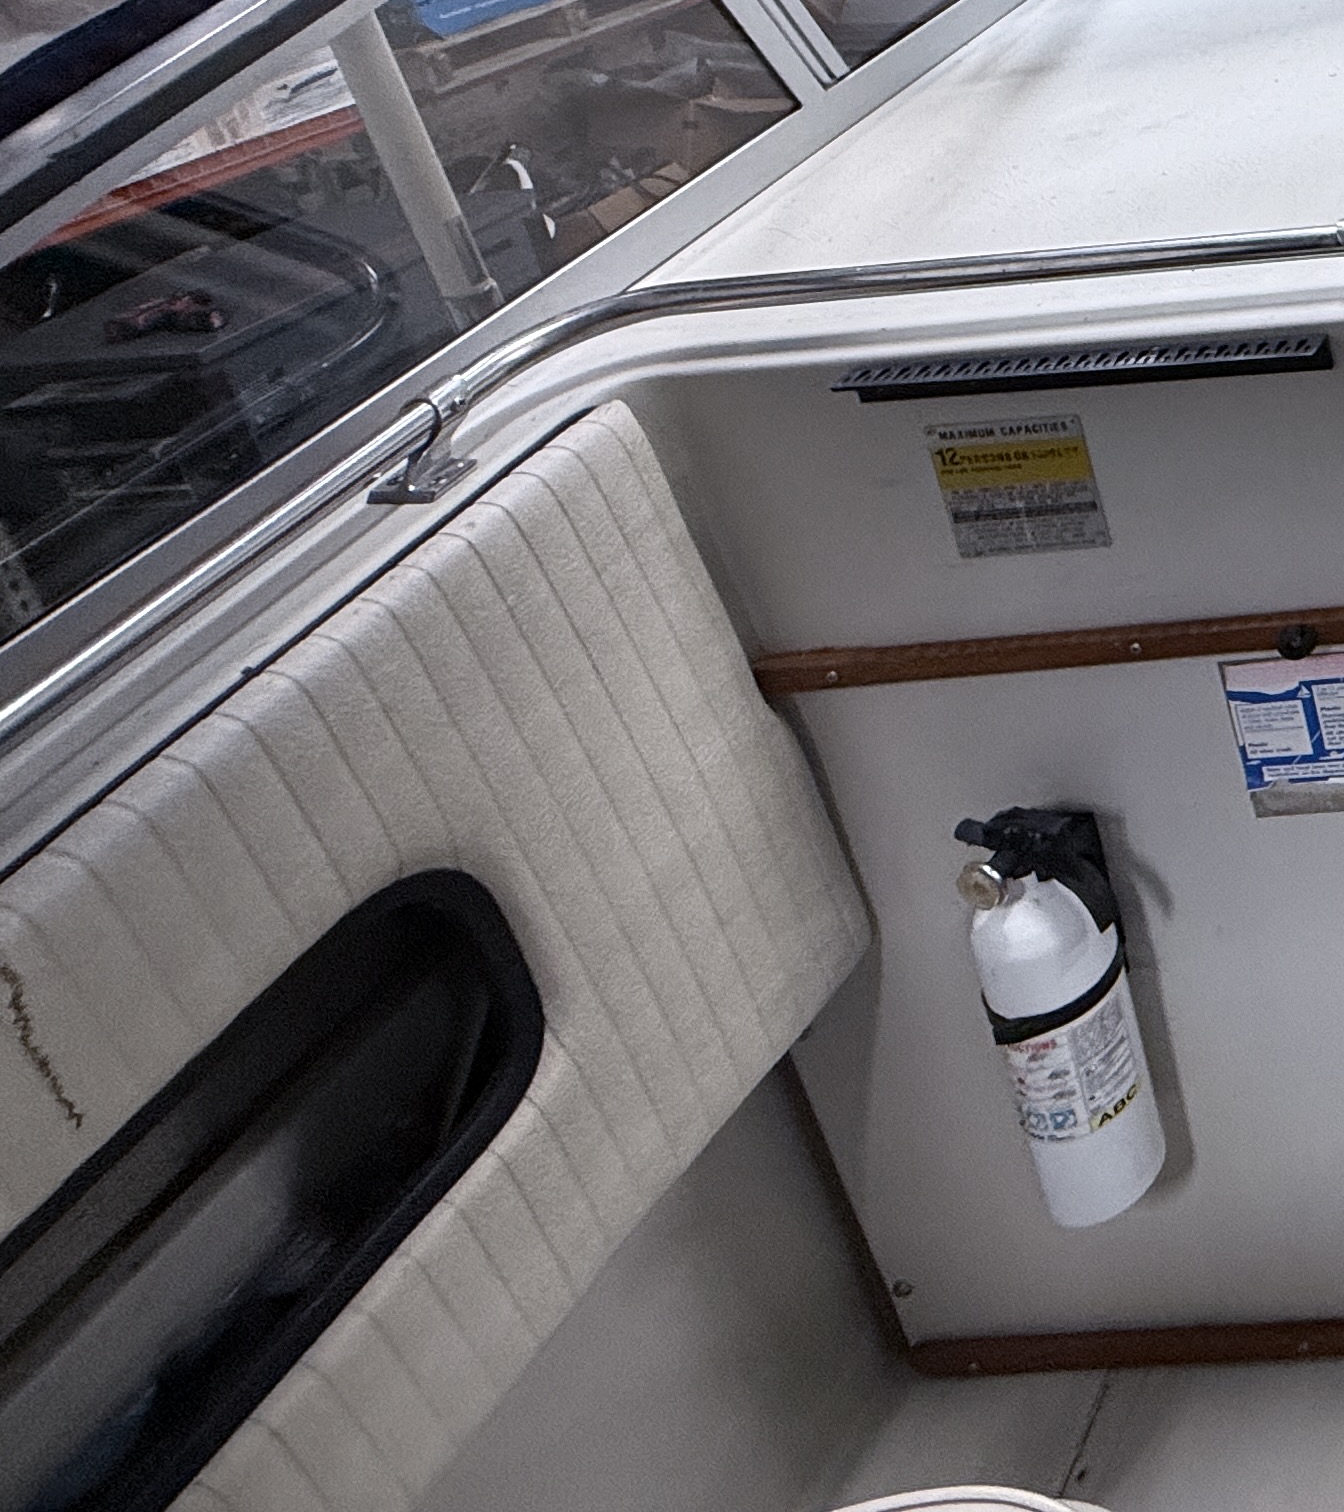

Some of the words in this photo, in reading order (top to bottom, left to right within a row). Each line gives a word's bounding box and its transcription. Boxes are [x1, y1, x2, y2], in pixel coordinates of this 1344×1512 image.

[938, 428, 995, 440] MAXIMUM
[1000, 421, 1068, 437] CAPACITIES
[935, 447, 961, 467] 12
[1098, 1084, 1138, 1128] ABC
